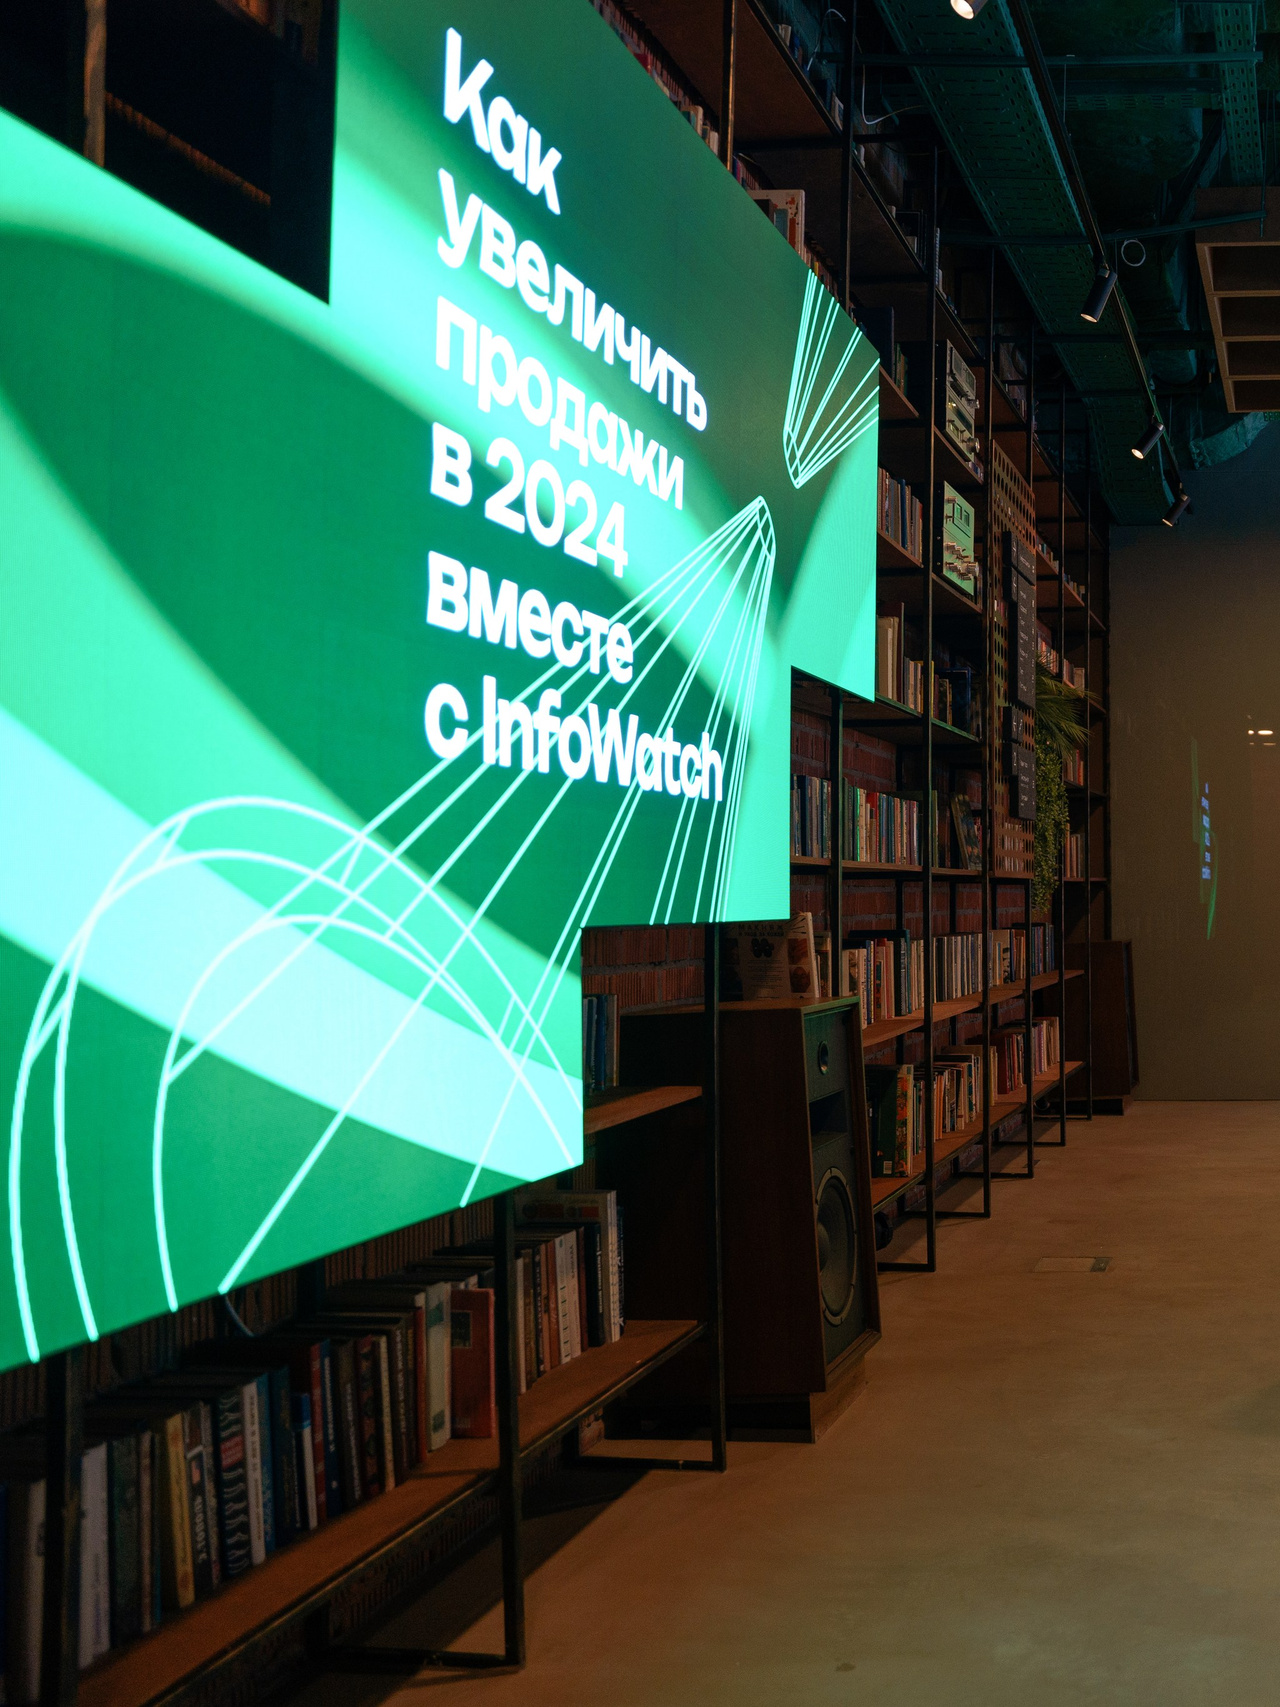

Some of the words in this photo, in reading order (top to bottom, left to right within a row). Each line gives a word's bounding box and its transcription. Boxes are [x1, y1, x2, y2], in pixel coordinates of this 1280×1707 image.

[443, 27, 562, 216] Как
[437, 167, 709, 432] увеличить
[435, 295, 685, 511] продажи
[484, 437, 629, 579] 2024
[426, 550, 634, 684] вместе
[424, 682, 470, 760] с
[482, 674, 723, 802] InfoWatch
